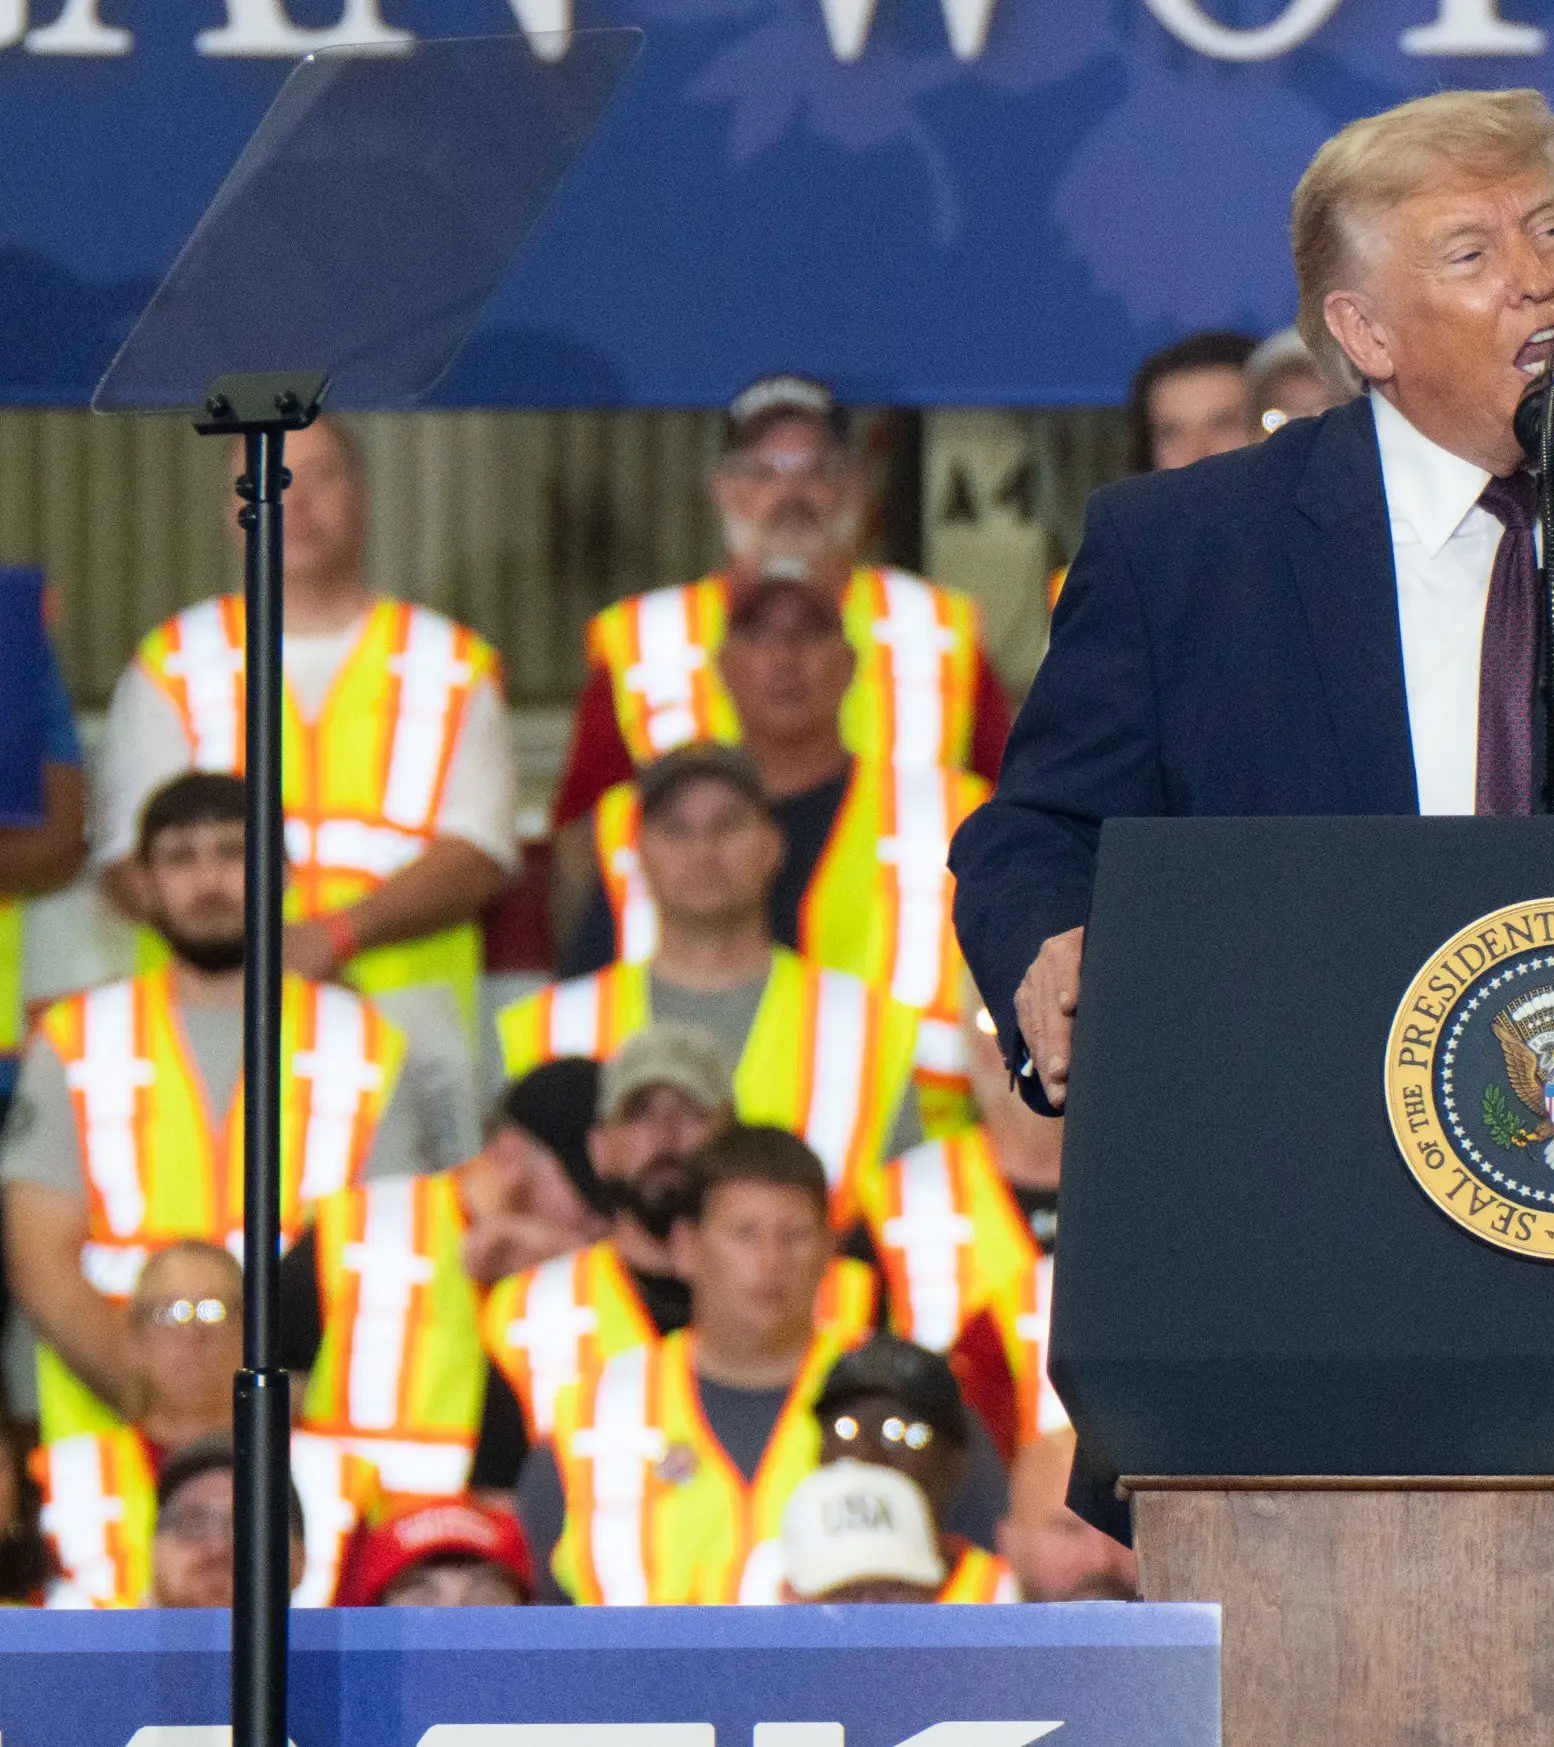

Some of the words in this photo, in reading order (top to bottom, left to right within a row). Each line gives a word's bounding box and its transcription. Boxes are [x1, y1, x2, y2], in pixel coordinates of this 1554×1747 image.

[1402, 1084, 1429, 1133] THE
[1416, 1139, 1445, 1170] OF
[1445, 1167, 1537, 1241] SEAL
[822, 1493, 894, 1537] USA
